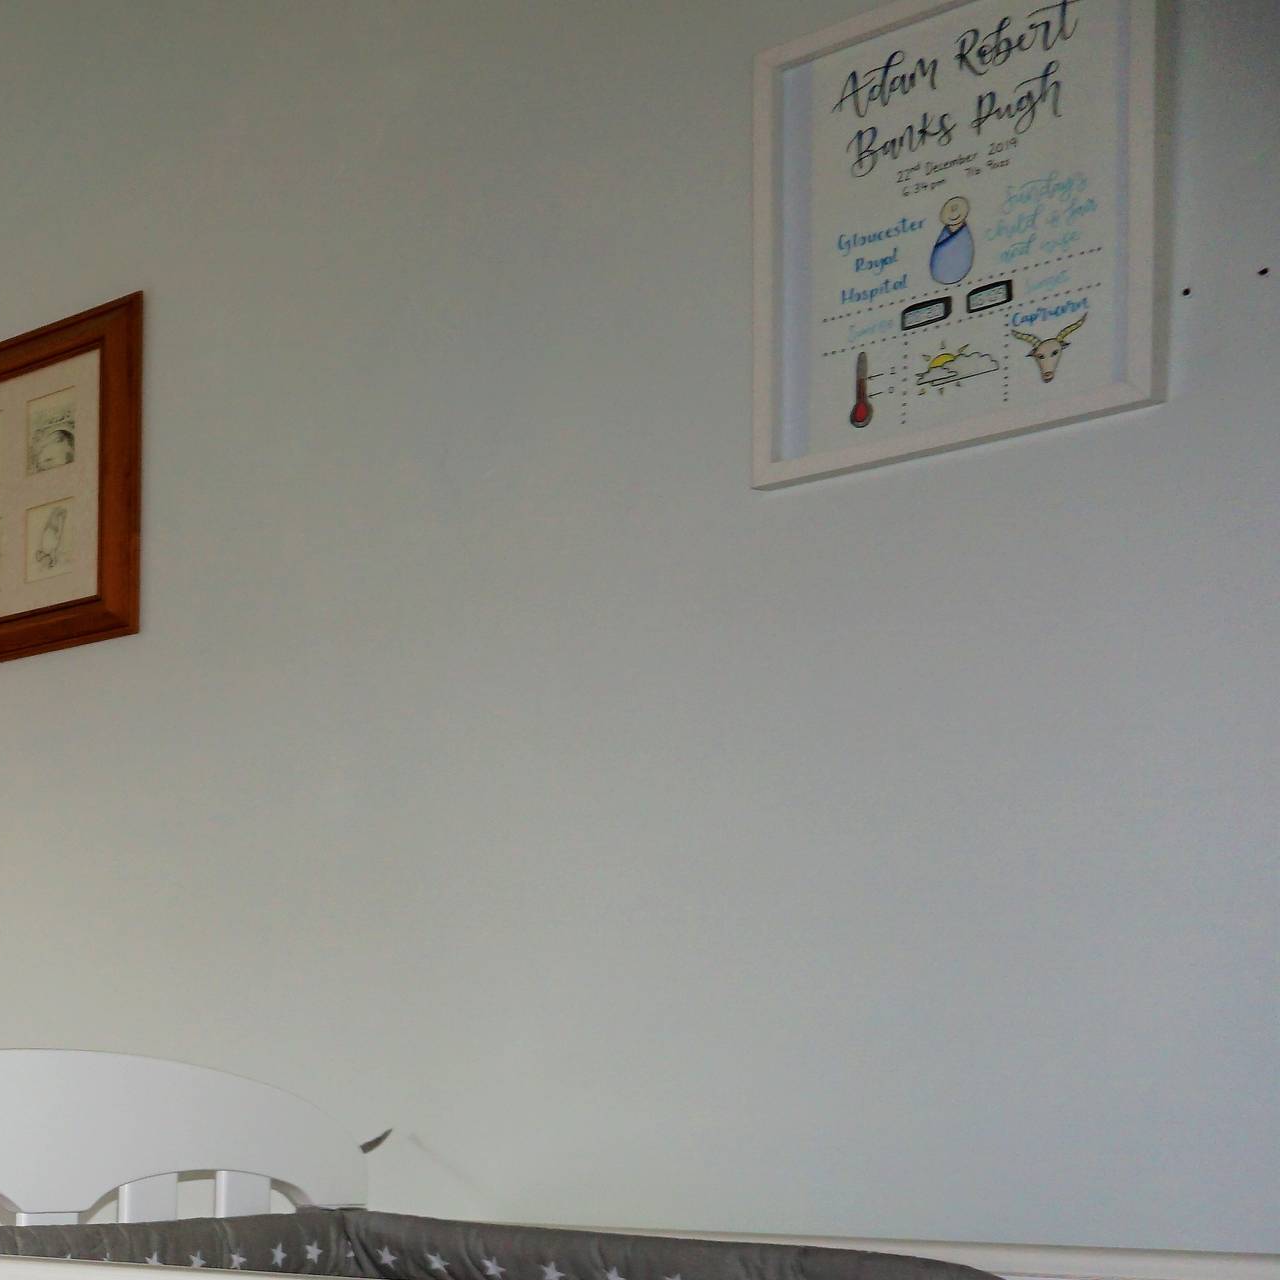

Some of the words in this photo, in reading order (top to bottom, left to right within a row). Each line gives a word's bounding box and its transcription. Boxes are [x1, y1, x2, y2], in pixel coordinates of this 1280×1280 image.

[831, 50, 938, 117] Adam
[954, 1, 1082, 75] Robert
[846, 112, 957, 177] Banks
[971, 60, 1062, 135] Pugh
[925, 152, 978, 176] December
[987, 137, 1018, 155] 2019
[837, 217, 928, 257] Gloucester
[855, 248, 899, 276] Royal
[841, 272, 909, 305] Hospital
[1011, 297, 1089, 327] Capricorn
